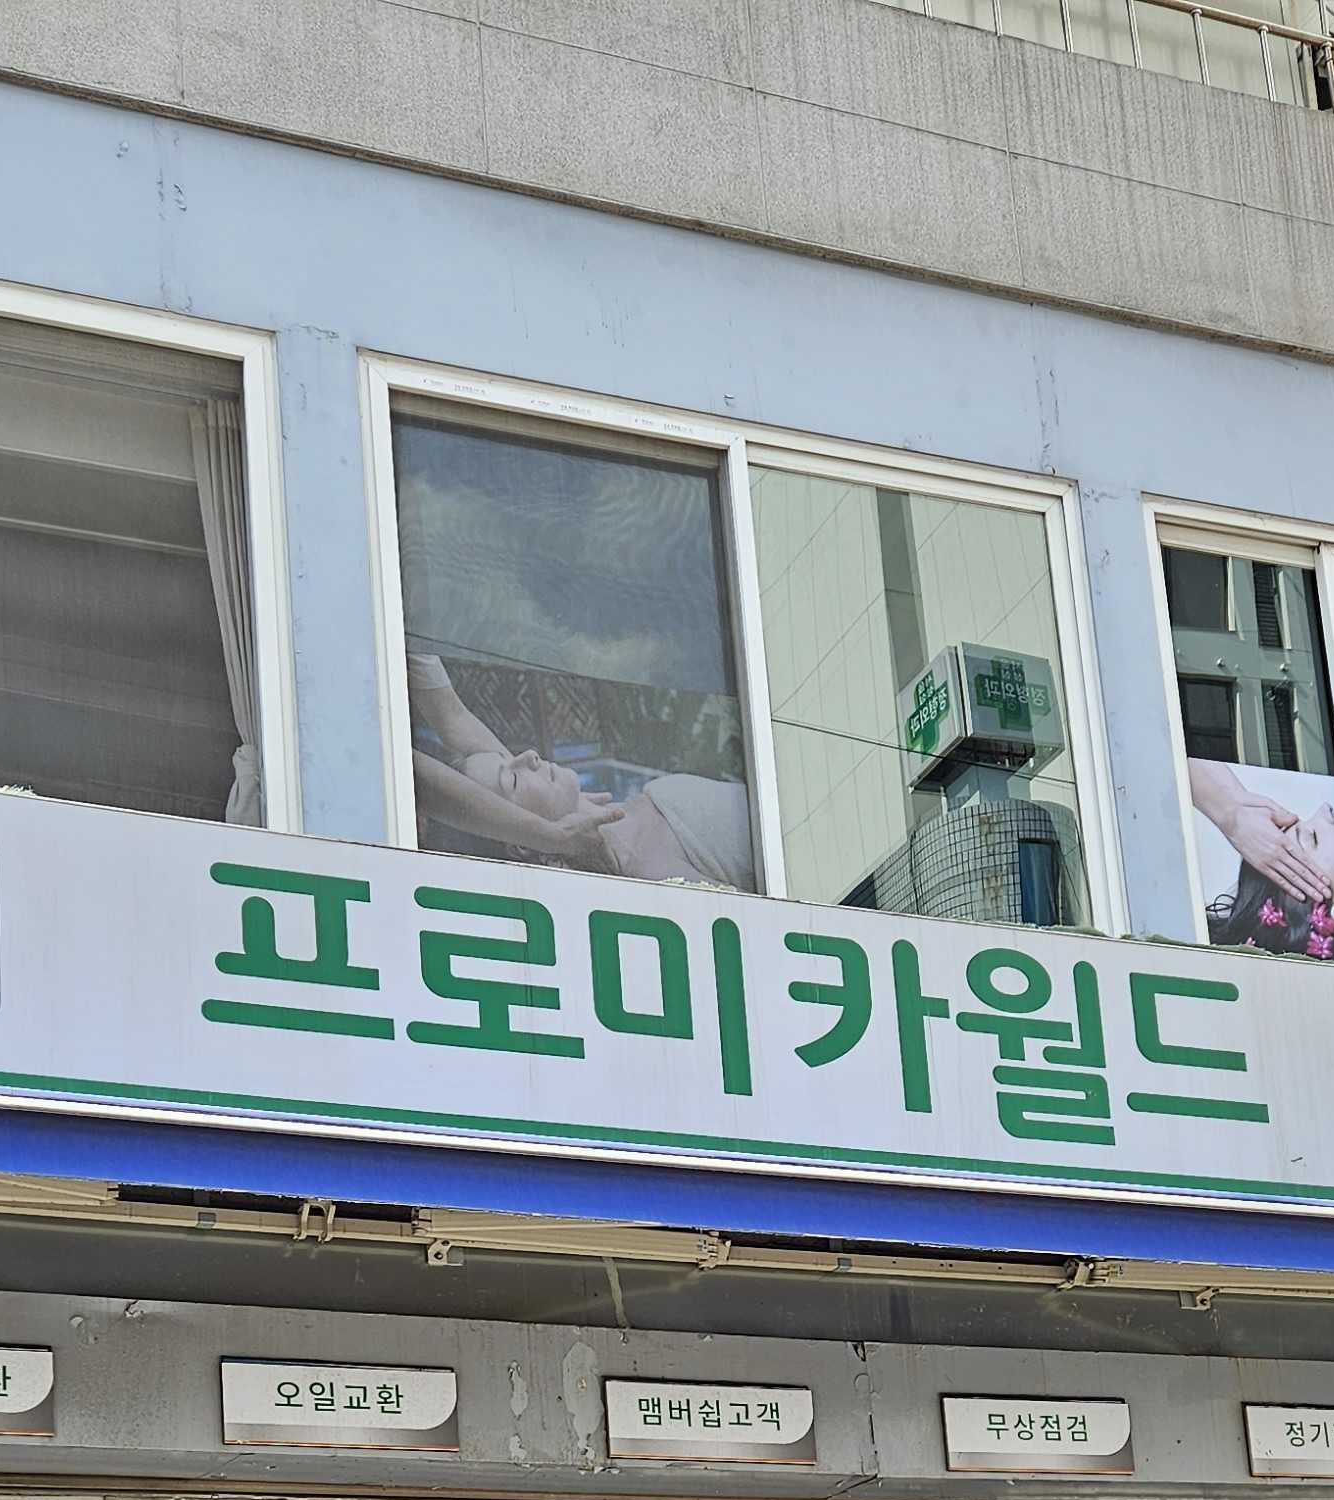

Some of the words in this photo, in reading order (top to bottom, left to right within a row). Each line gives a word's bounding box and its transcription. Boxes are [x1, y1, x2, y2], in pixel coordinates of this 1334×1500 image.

[201, 861, 1270, 1146] 프로미카월드
[274, 1381, 404, 1415] 오일교환
[637, 1396, 781, 1431] 맴버쉽고객
[986, 1411, 1089, 1442] 무상점검
